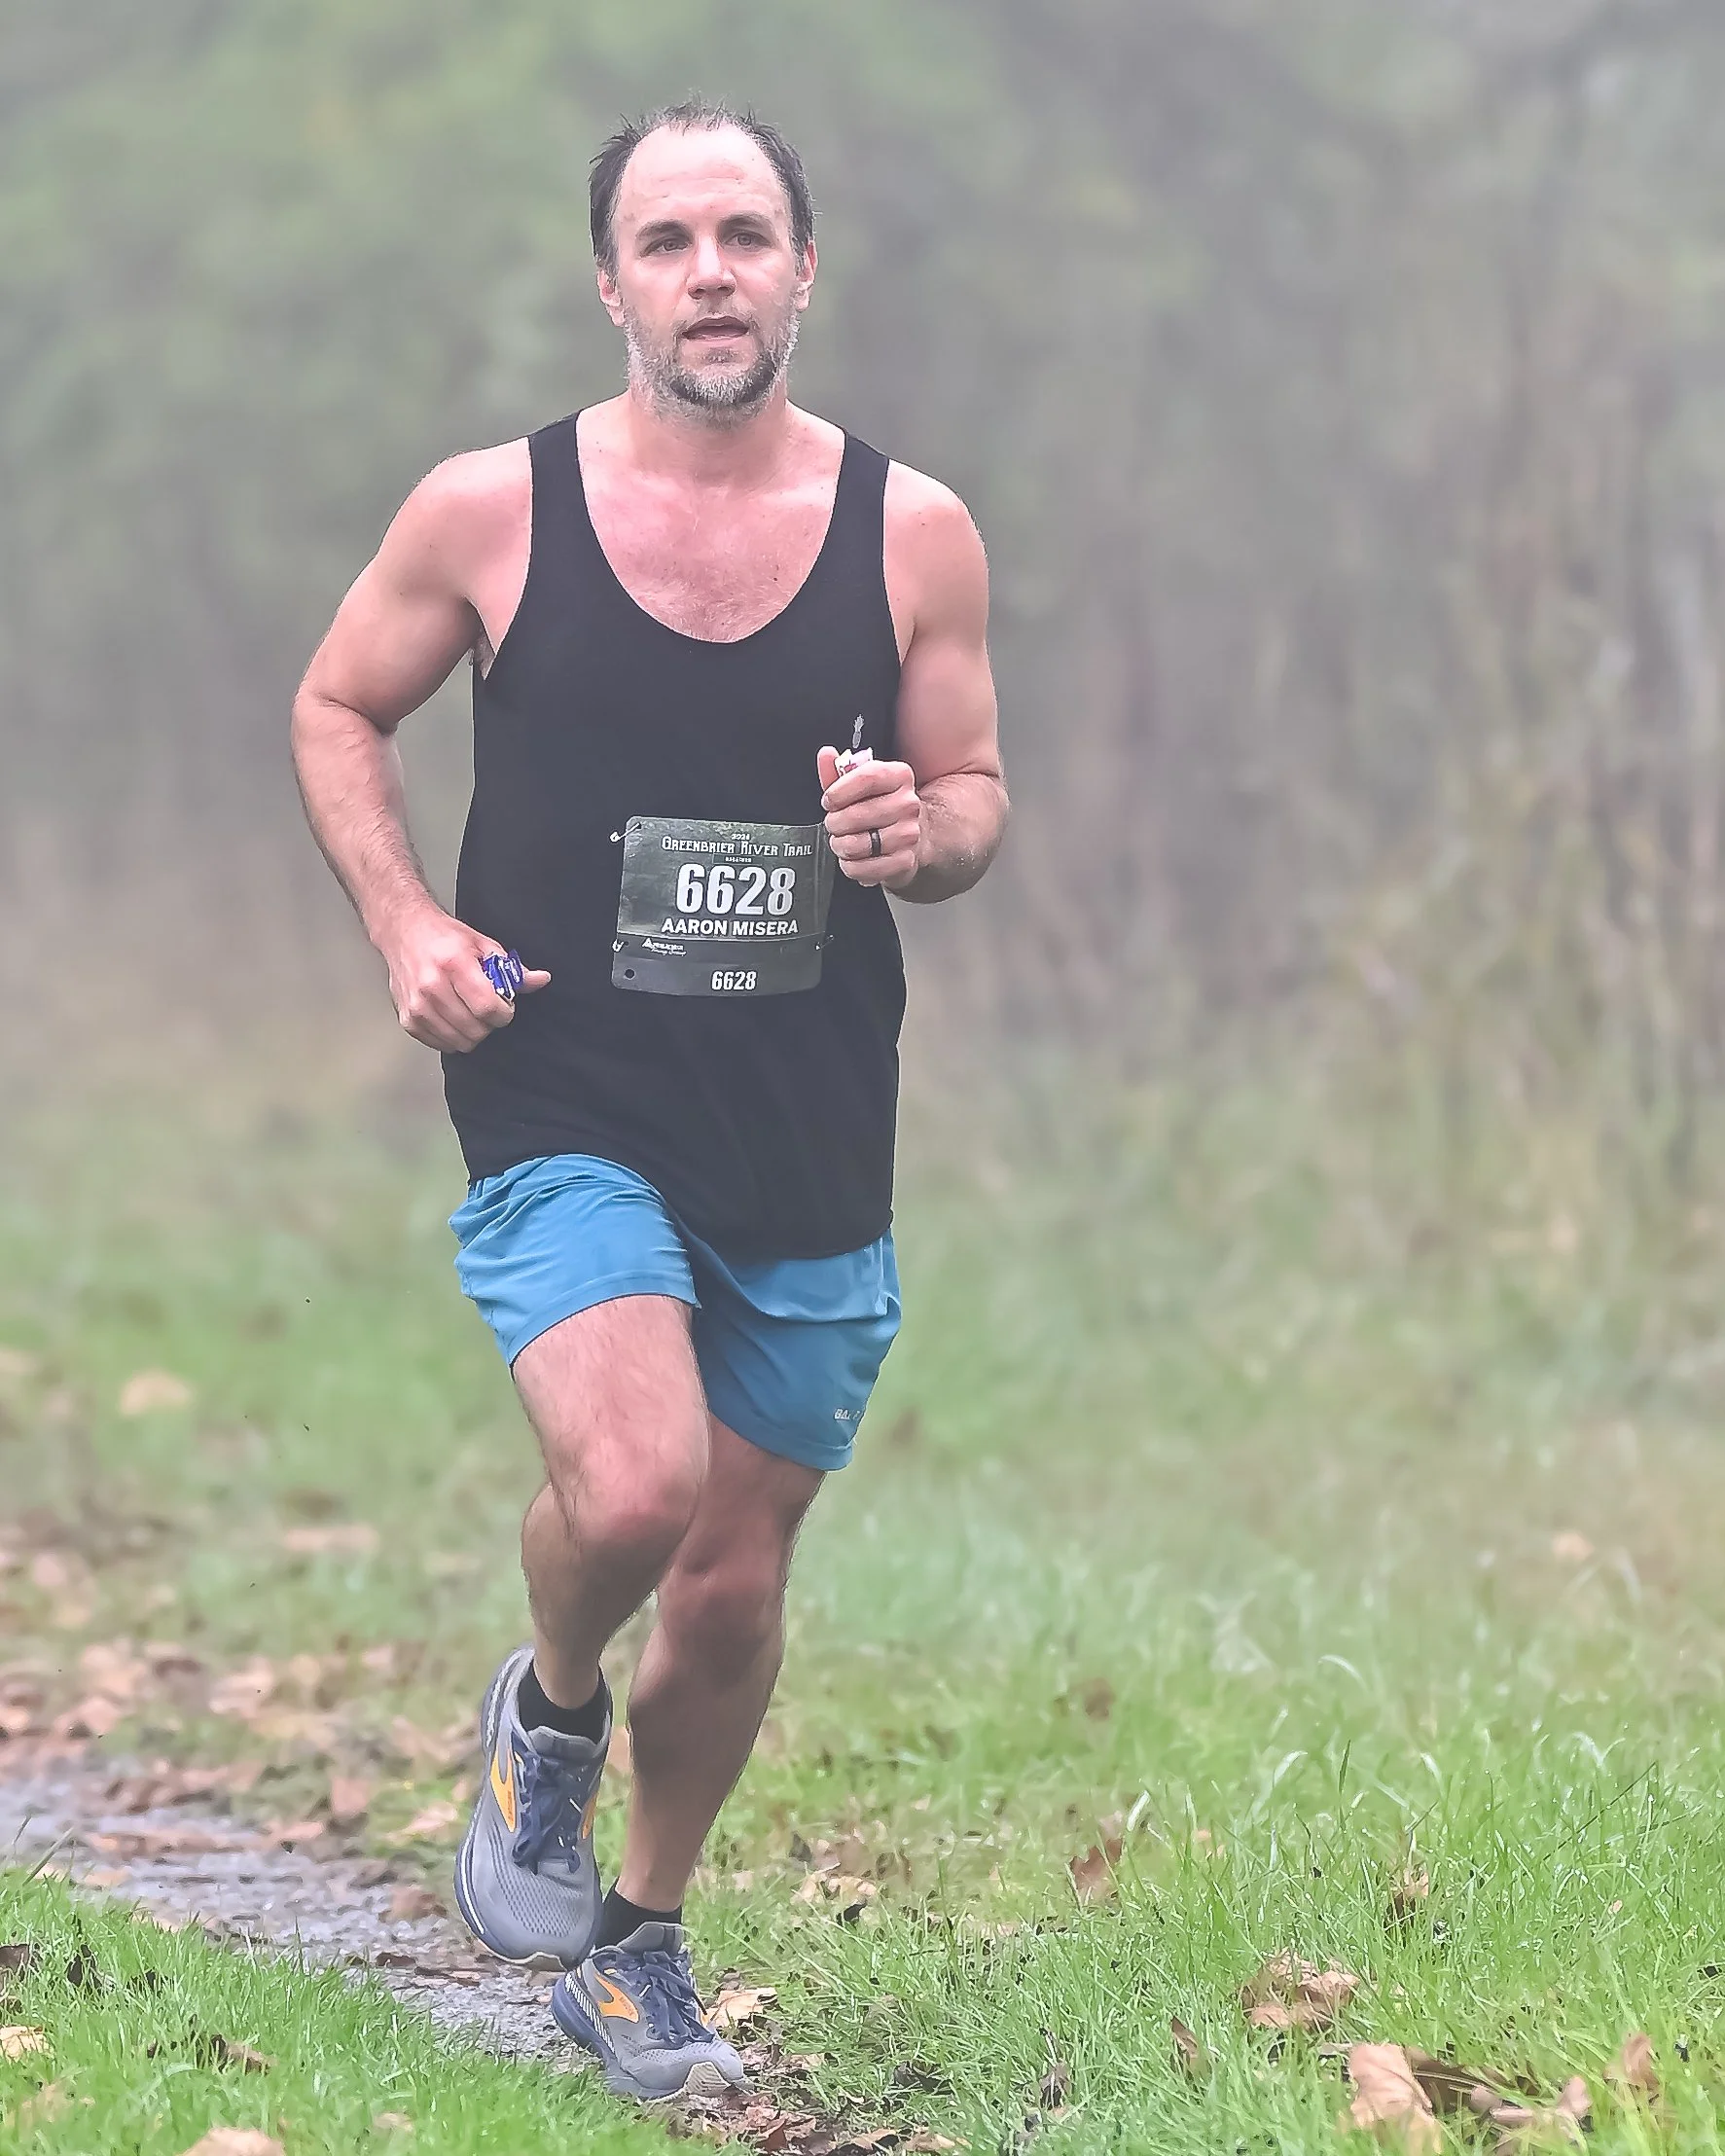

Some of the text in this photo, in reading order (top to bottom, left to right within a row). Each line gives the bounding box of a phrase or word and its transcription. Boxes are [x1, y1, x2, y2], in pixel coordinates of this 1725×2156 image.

[662, 835, 813, 857] GREENBRIER RIVER TRAIL
[676, 863, 796, 916] 6628
[662, 917, 799, 936] AARON MISERA
[711, 971, 757, 990] 6628
